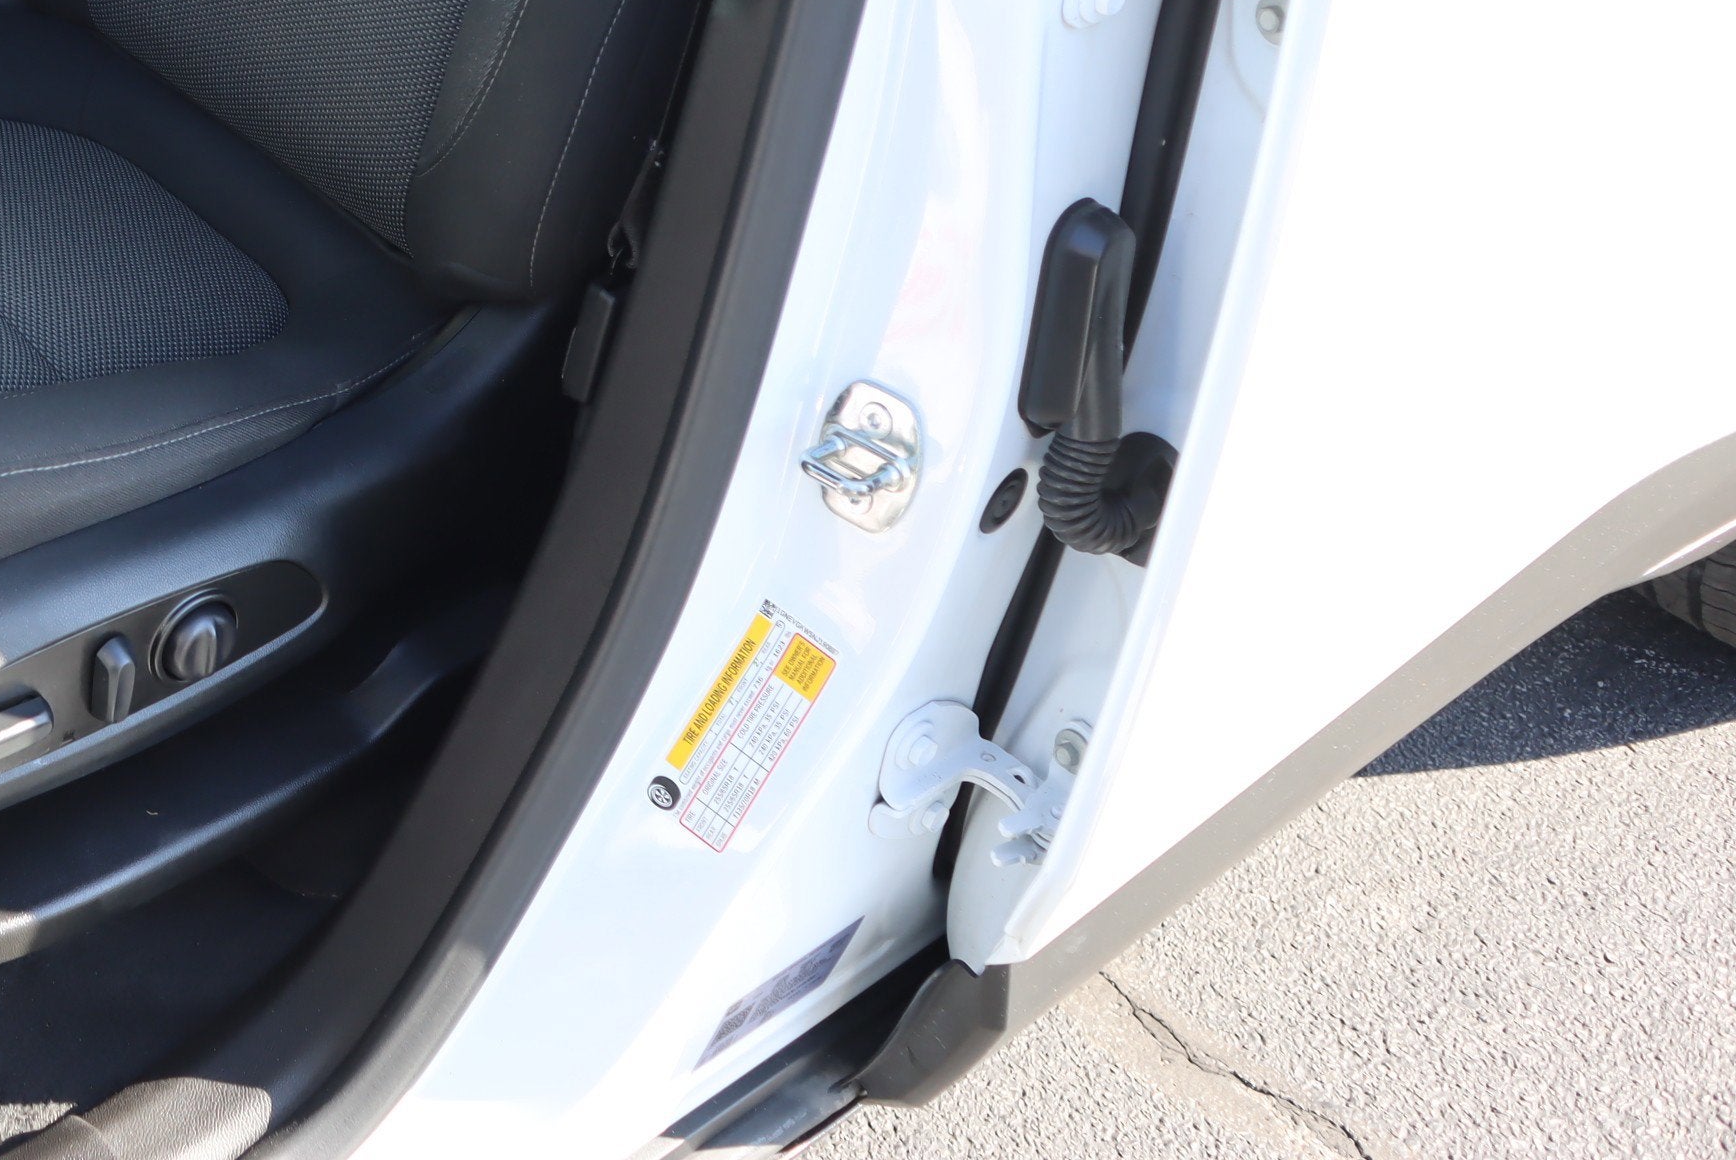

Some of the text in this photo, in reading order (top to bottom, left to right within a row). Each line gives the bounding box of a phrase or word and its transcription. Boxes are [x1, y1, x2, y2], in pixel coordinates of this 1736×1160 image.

[682, 638, 755, 745] TIRE AND LOADING INFORMATION
